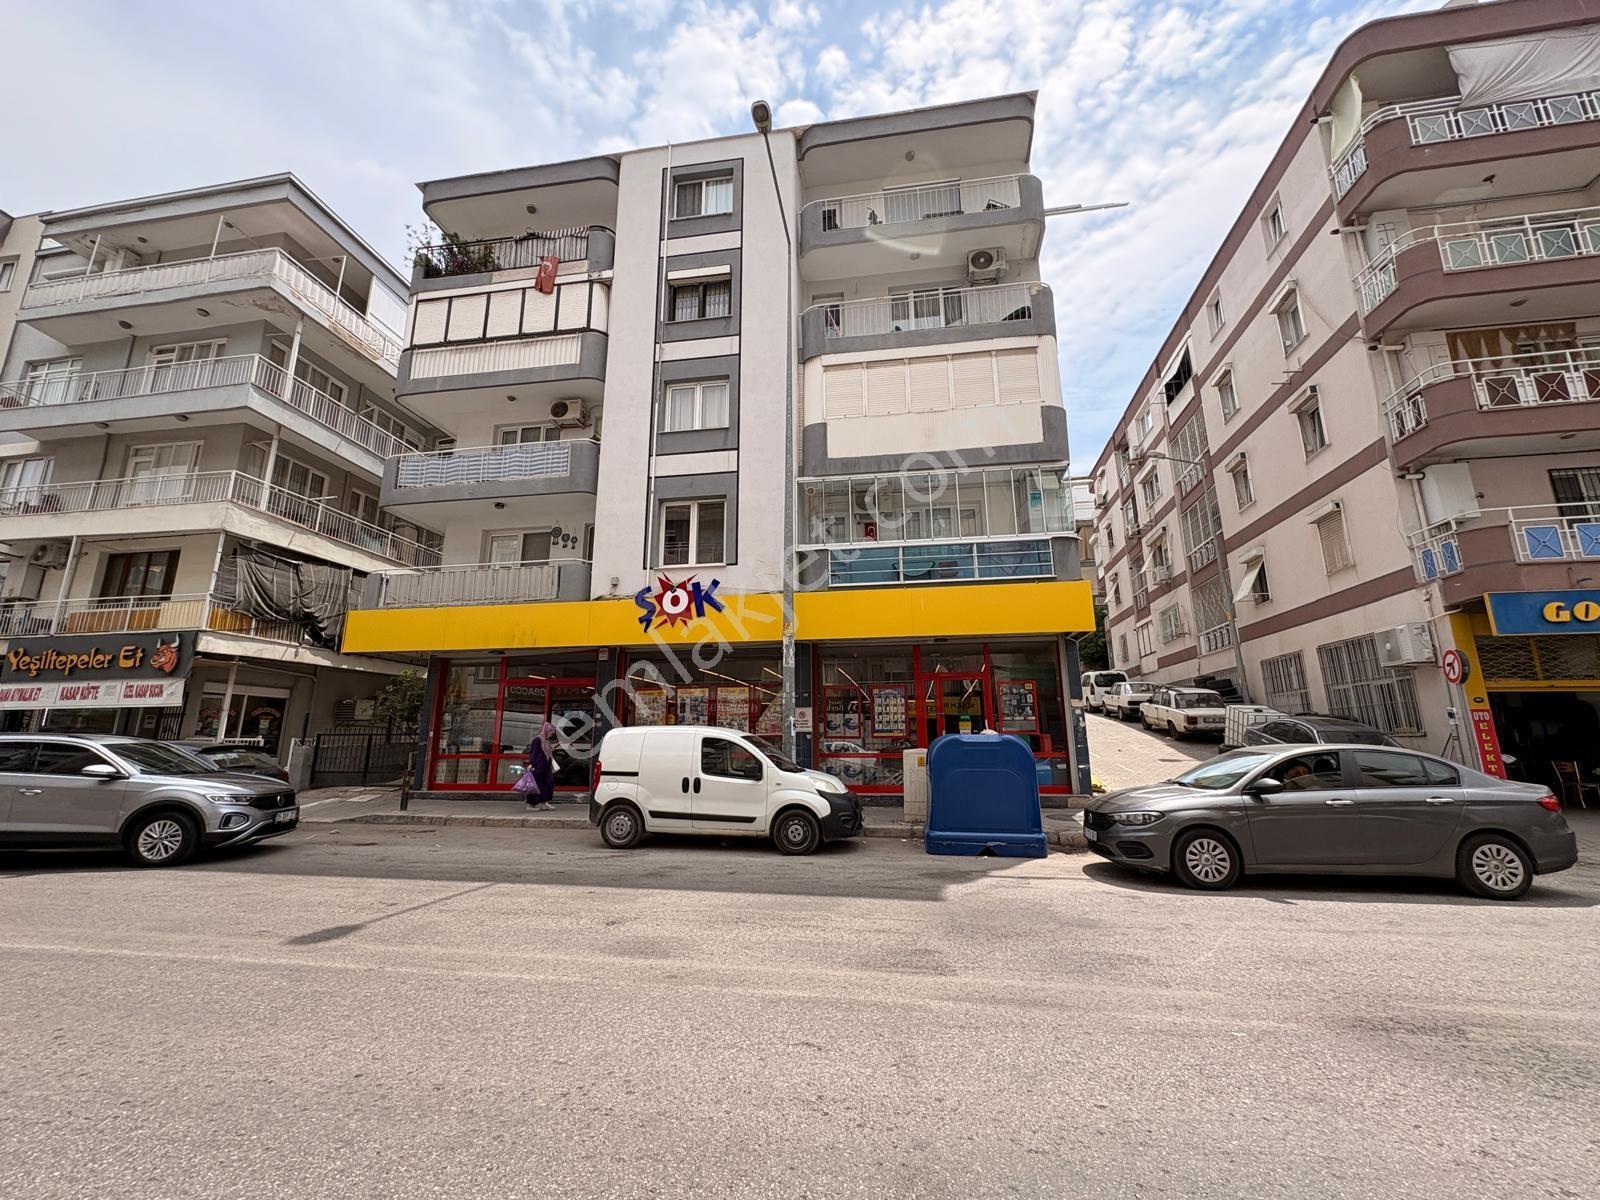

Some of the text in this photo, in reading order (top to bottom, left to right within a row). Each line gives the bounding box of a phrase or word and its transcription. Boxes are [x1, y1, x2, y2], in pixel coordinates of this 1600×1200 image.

[634, 578, 726, 633] ŞOK
[7, 645, 144, 677] Yeşiltepeler Et
[59, 686, 81, 701] KASAP
[1473, 711, 1490, 720] OTO
[1479, 722, 1501, 779] ELEKT
